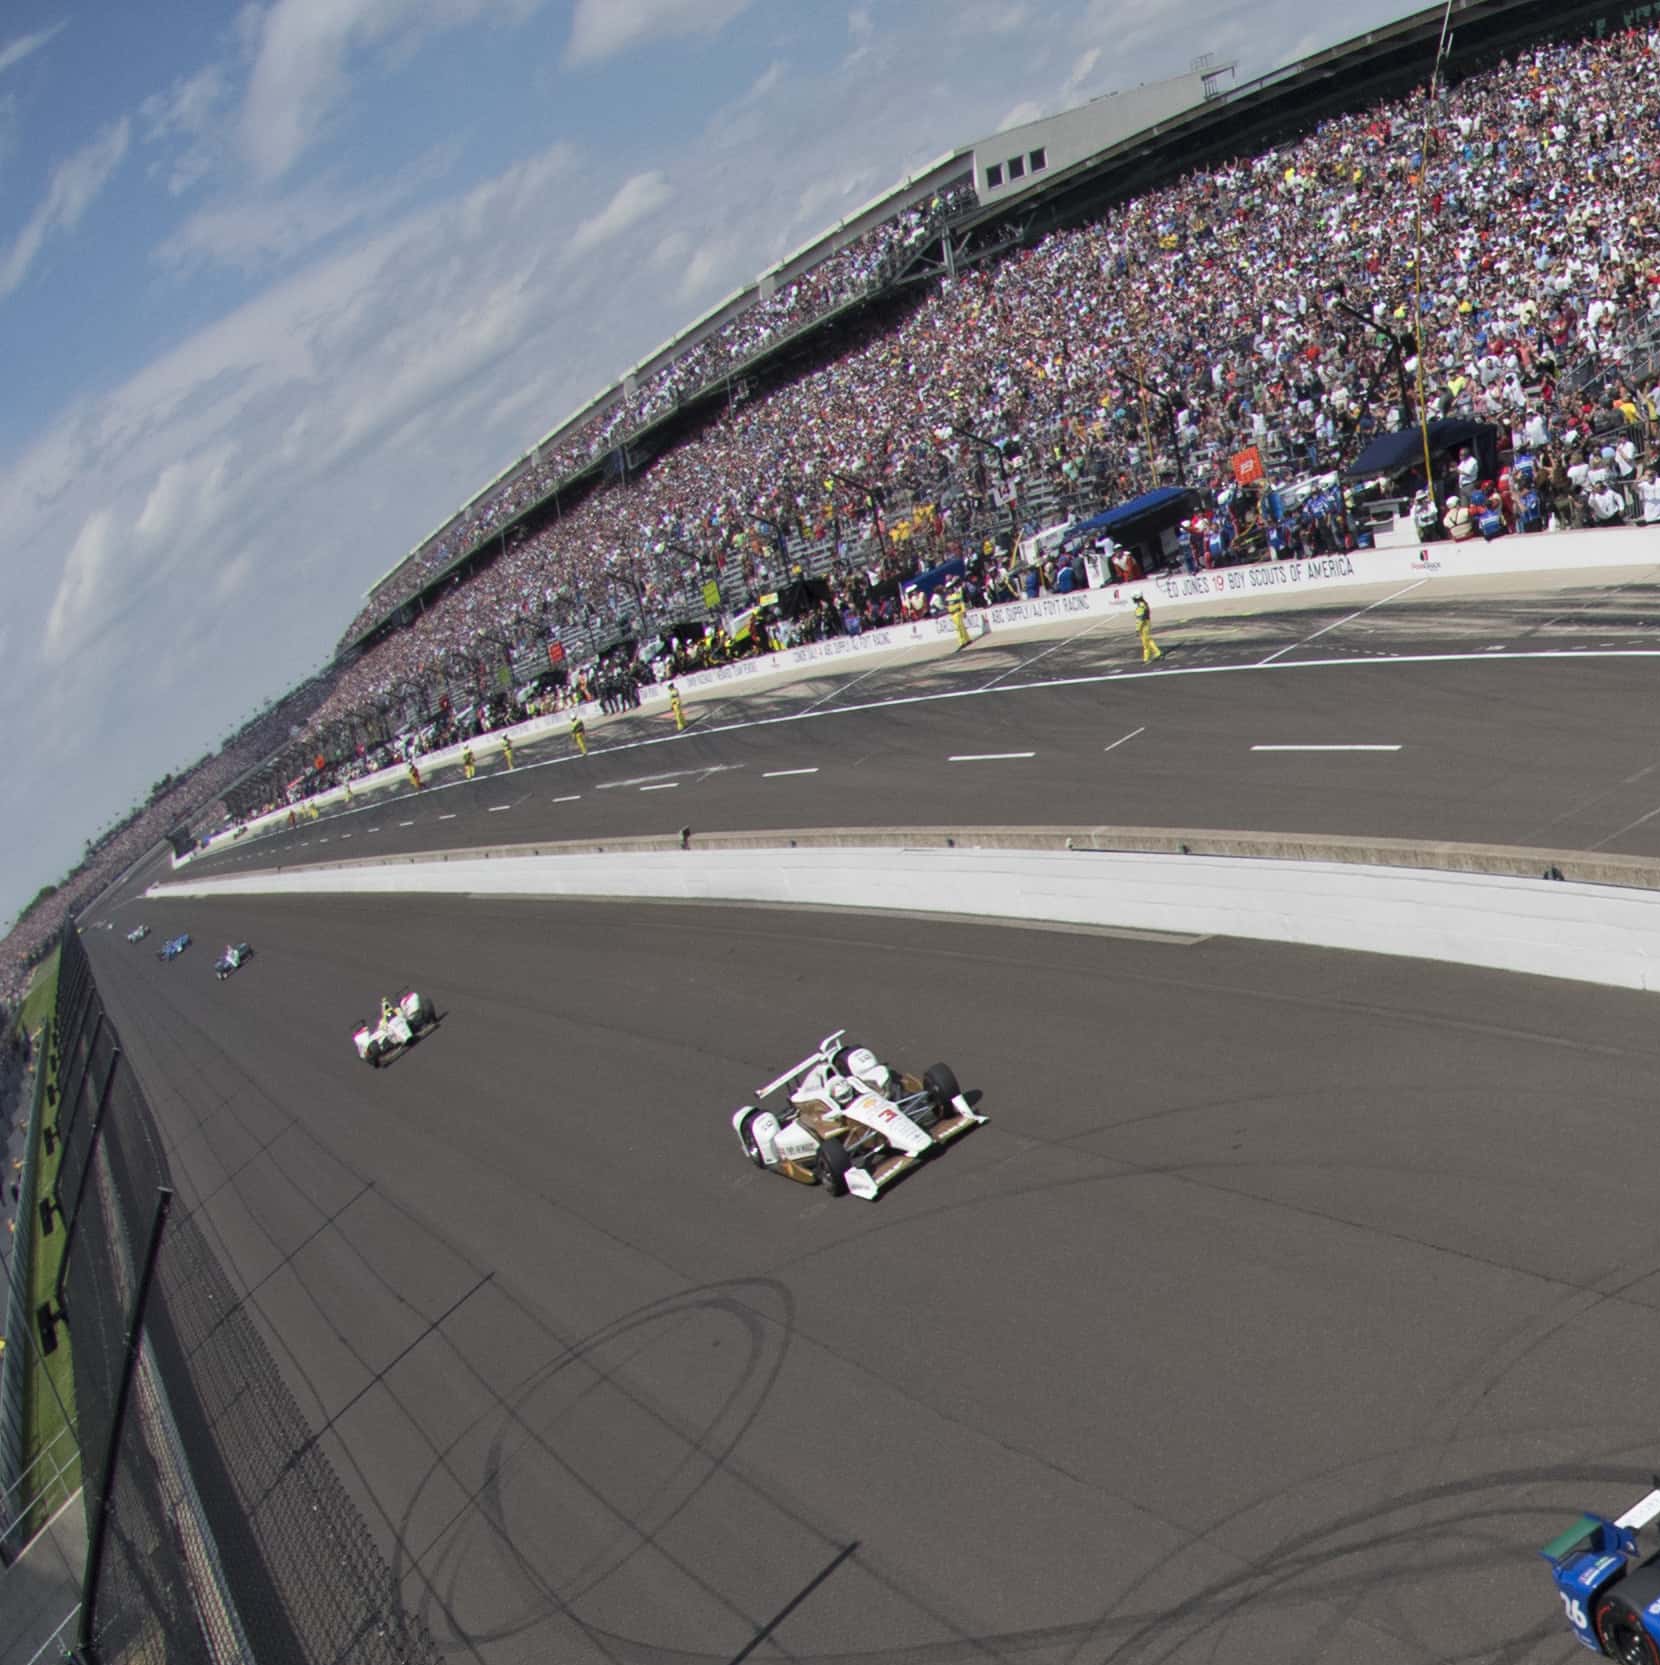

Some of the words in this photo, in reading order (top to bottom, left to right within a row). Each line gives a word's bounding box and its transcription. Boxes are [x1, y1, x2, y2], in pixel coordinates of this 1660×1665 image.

[1165, 581, 1178, 599] ED
[1179, 577, 1209, 598] JONES
[1211, 574, 1225, 593] 19
[1228, 572, 1246, 592] BOY
[1249, 567, 1287, 591] SCOUTS
[1289, 565, 1302, 584] OF
[1306, 559, 1355, 582] AMERICA
